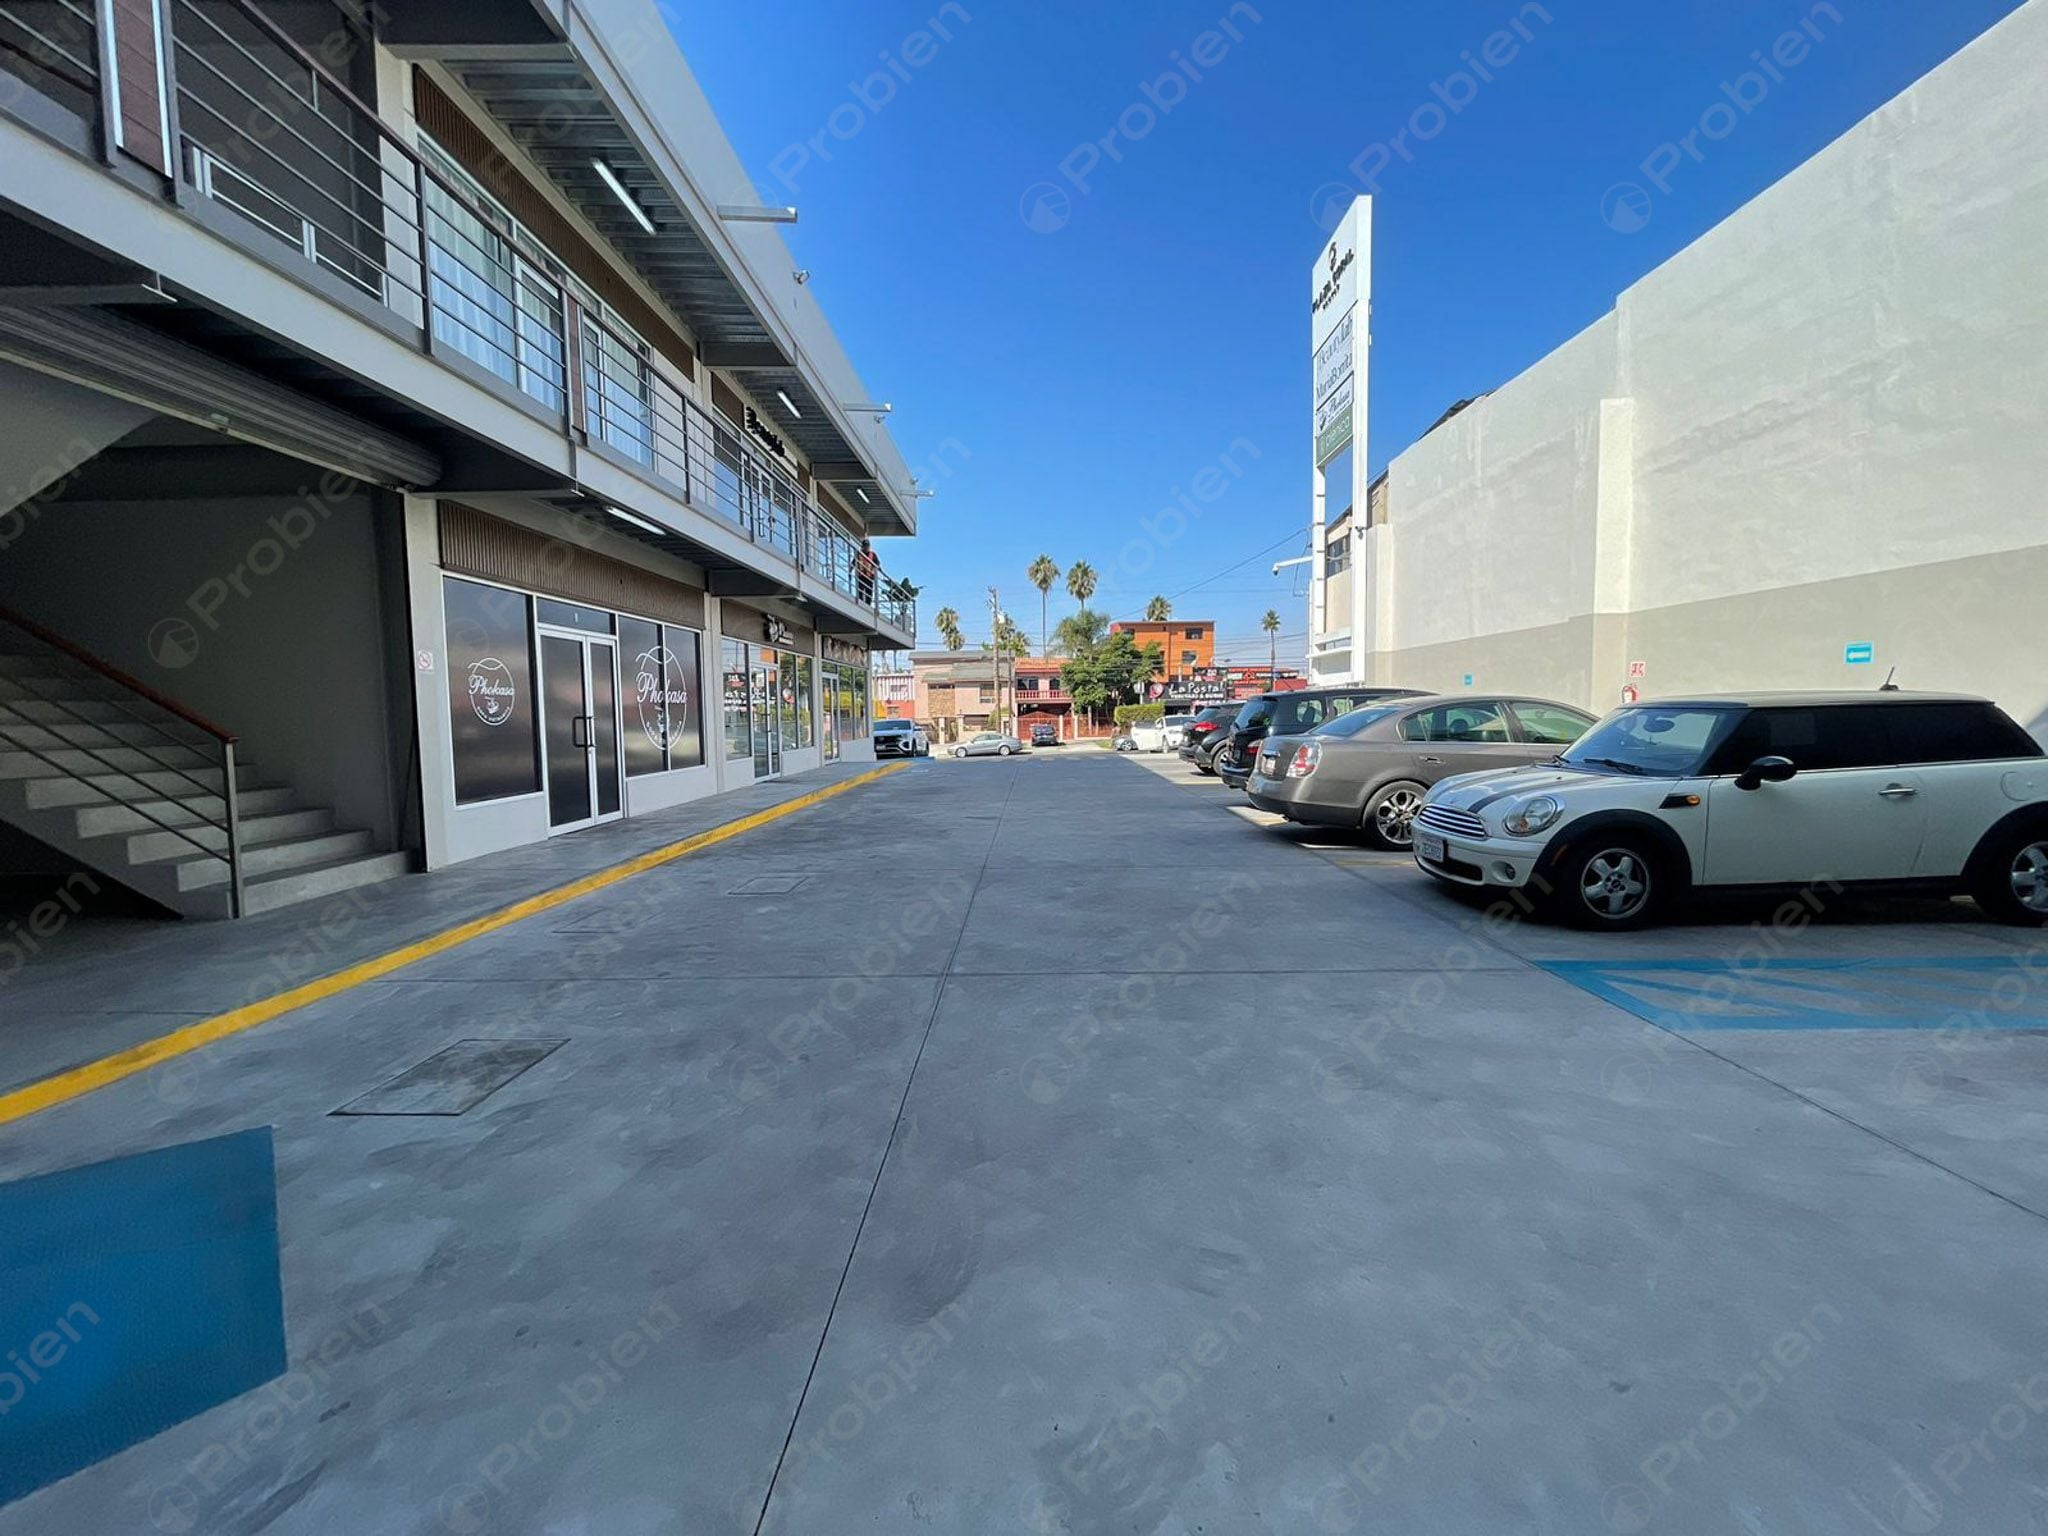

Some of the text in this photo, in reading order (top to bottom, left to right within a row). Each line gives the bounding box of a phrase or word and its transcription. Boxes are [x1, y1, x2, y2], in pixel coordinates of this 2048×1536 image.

[468, 673, 515, 696] Phokasa
[1168, 683, 1186, 695] La
[1188, 682, 1224, 693] Postal
